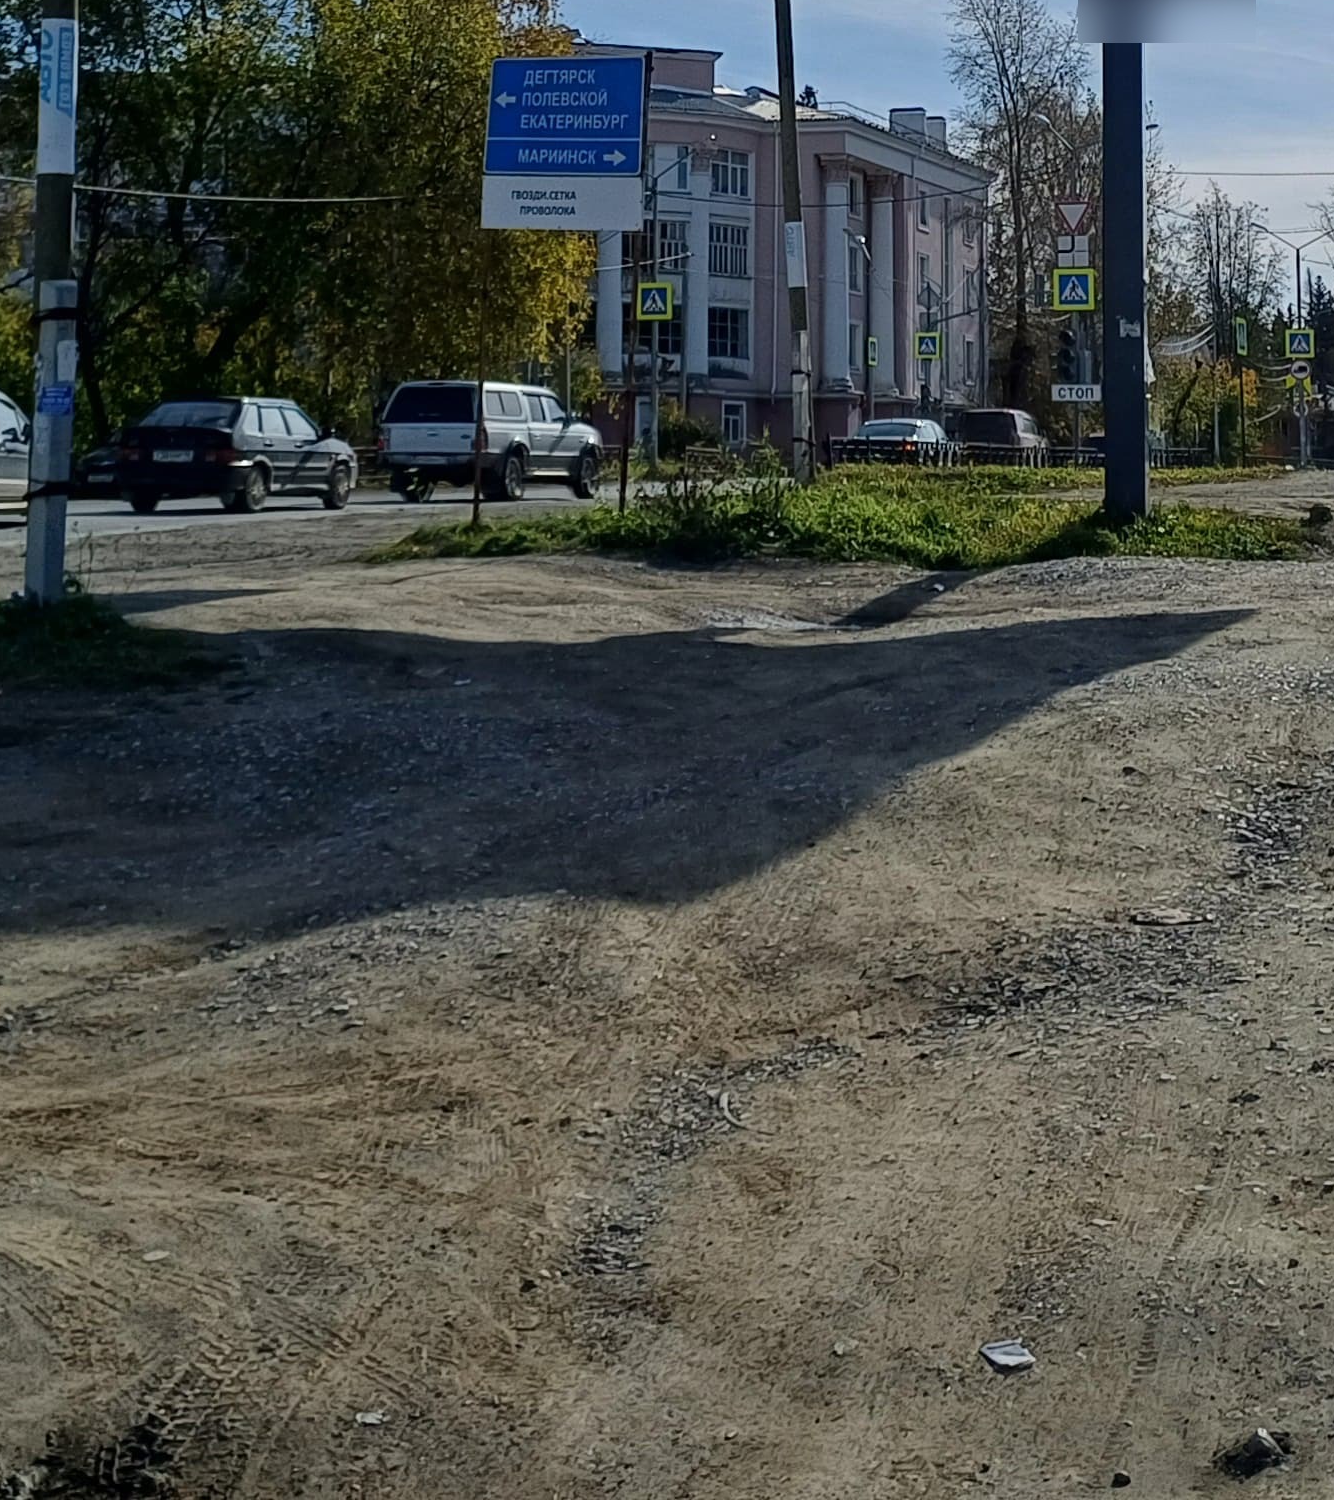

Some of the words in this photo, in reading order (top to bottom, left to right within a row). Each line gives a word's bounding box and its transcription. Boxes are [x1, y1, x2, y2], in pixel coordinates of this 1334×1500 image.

[523, 69, 596, 87] ДЕГТЯРСК
[521, 88, 608, 107] ПОЛЕВСКОЙ
[519, 113, 629, 130] ЕКАТЕРИНБУРГ
[517, 148, 597, 165] МАРИИНСК
[519, 205, 576, 216] ПРОВОЛОКА
[1058, 387, 1094, 399] СТОП
